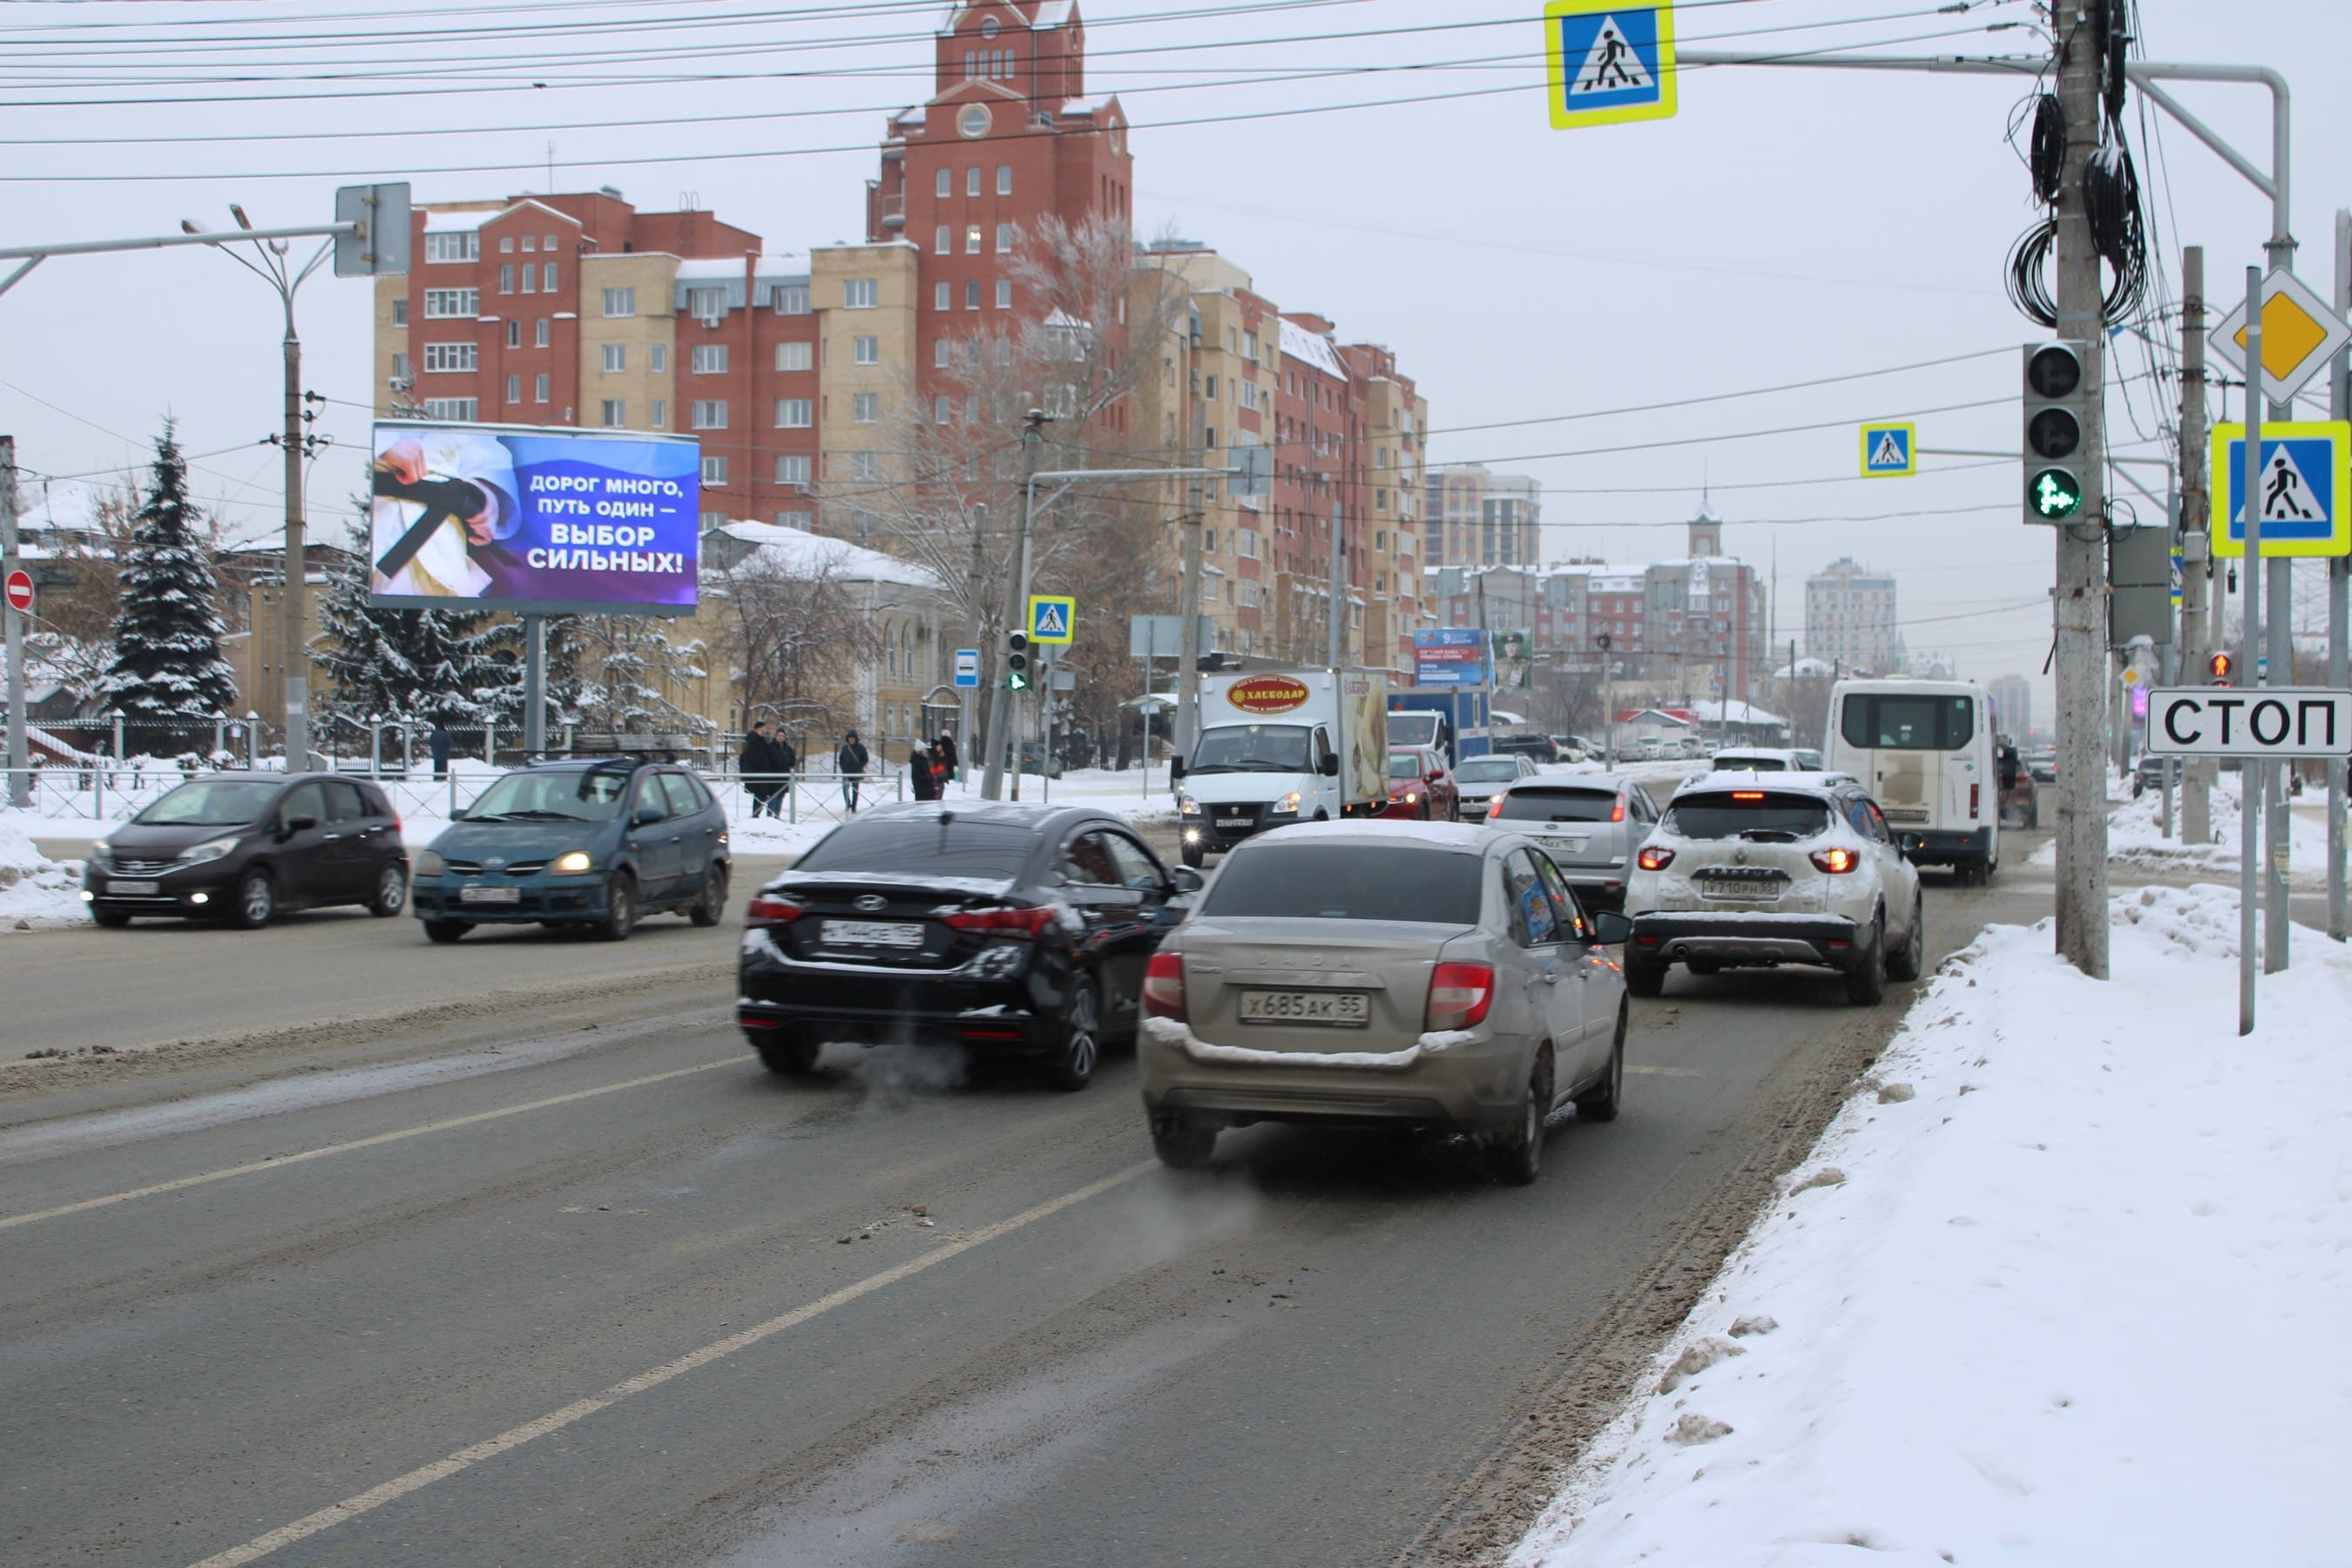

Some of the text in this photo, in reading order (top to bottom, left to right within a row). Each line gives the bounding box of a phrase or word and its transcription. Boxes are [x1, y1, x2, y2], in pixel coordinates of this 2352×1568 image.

[530, 475, 684, 498] ДОРОГ МНОГО,
[538, 498, 591, 515] ПУТЬ
[596, 501, 654, 518] ОДИН
[551, 524, 655, 547] ВЫБОР
[527, 548, 684, 574] СИЛЬНЫХ!
[1247, 689, 1305, 700] ХЛЕБОДАР
[2164, 699, 2335, 746] СТОП
